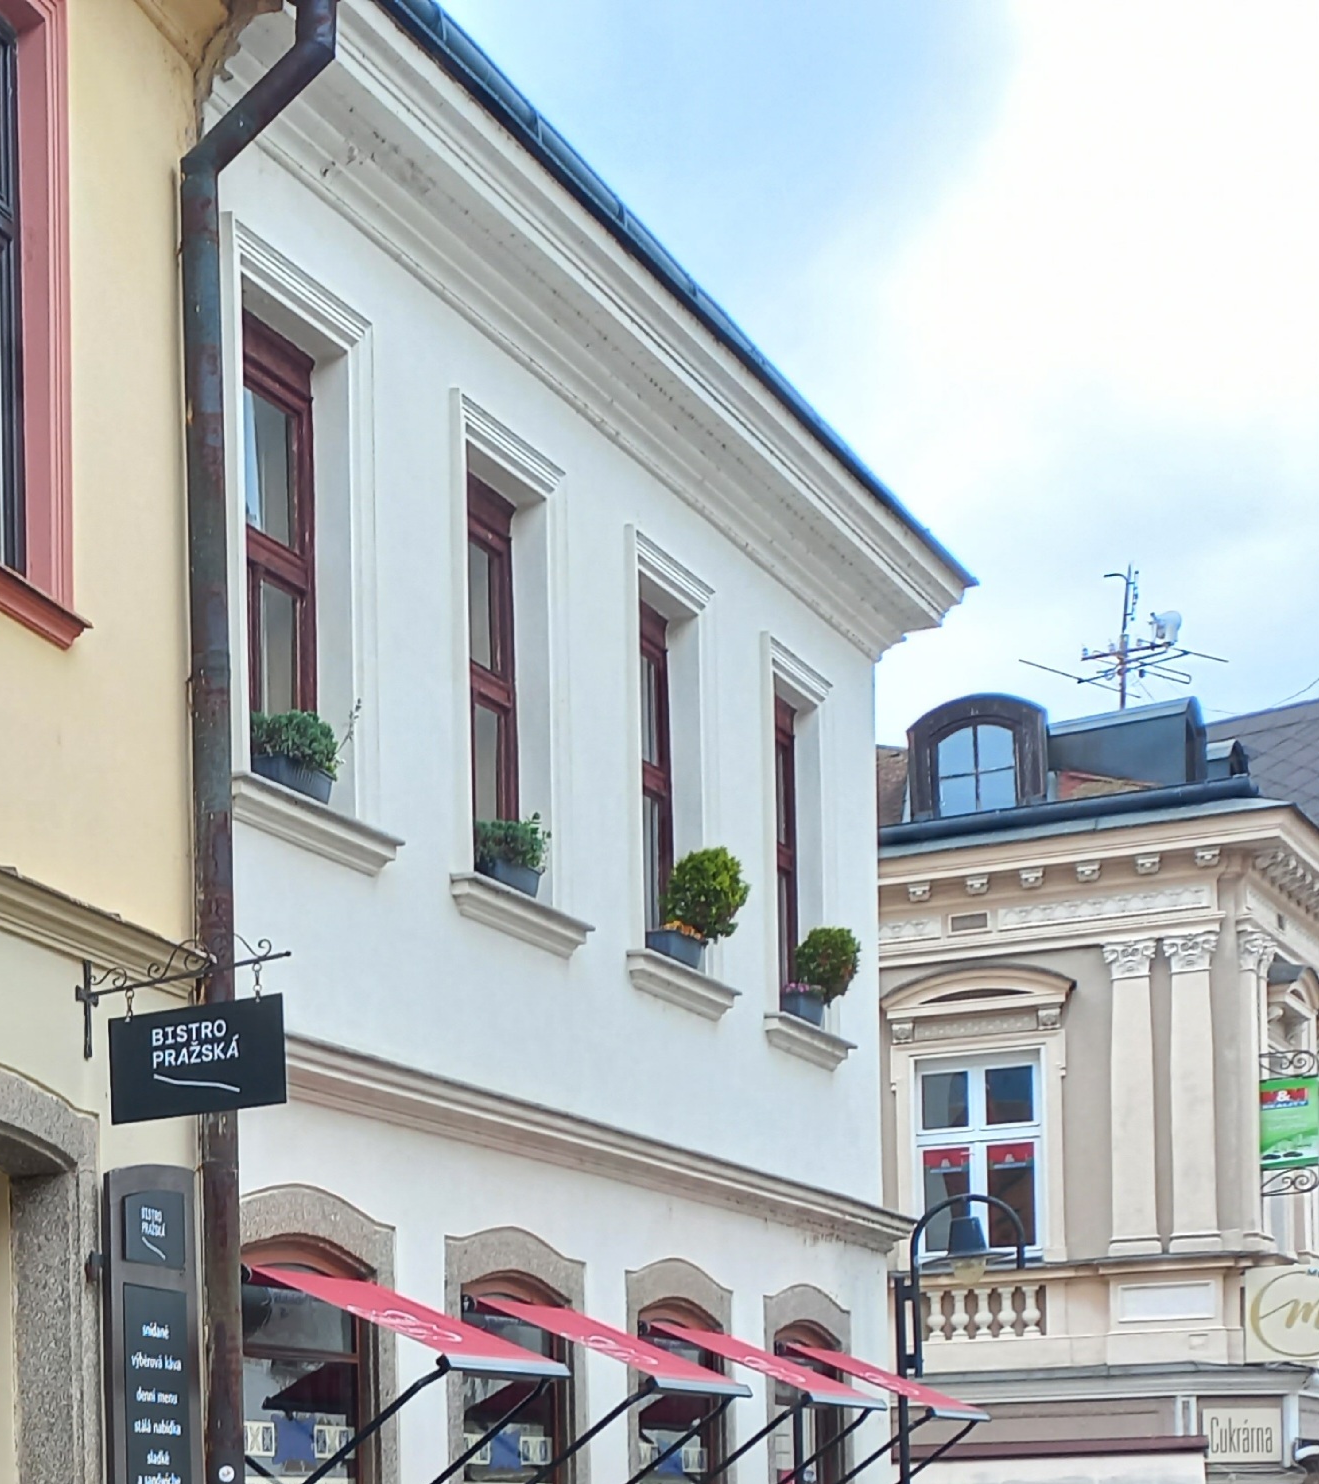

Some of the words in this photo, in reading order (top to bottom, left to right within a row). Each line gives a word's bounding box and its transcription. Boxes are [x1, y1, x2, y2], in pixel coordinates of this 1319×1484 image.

[151, 1019, 227, 1047] BISTRO
[152, 1033, 239, 1069] PRAŽSKÁ
[1210, 1416, 1273, 1453] Cukrárna
